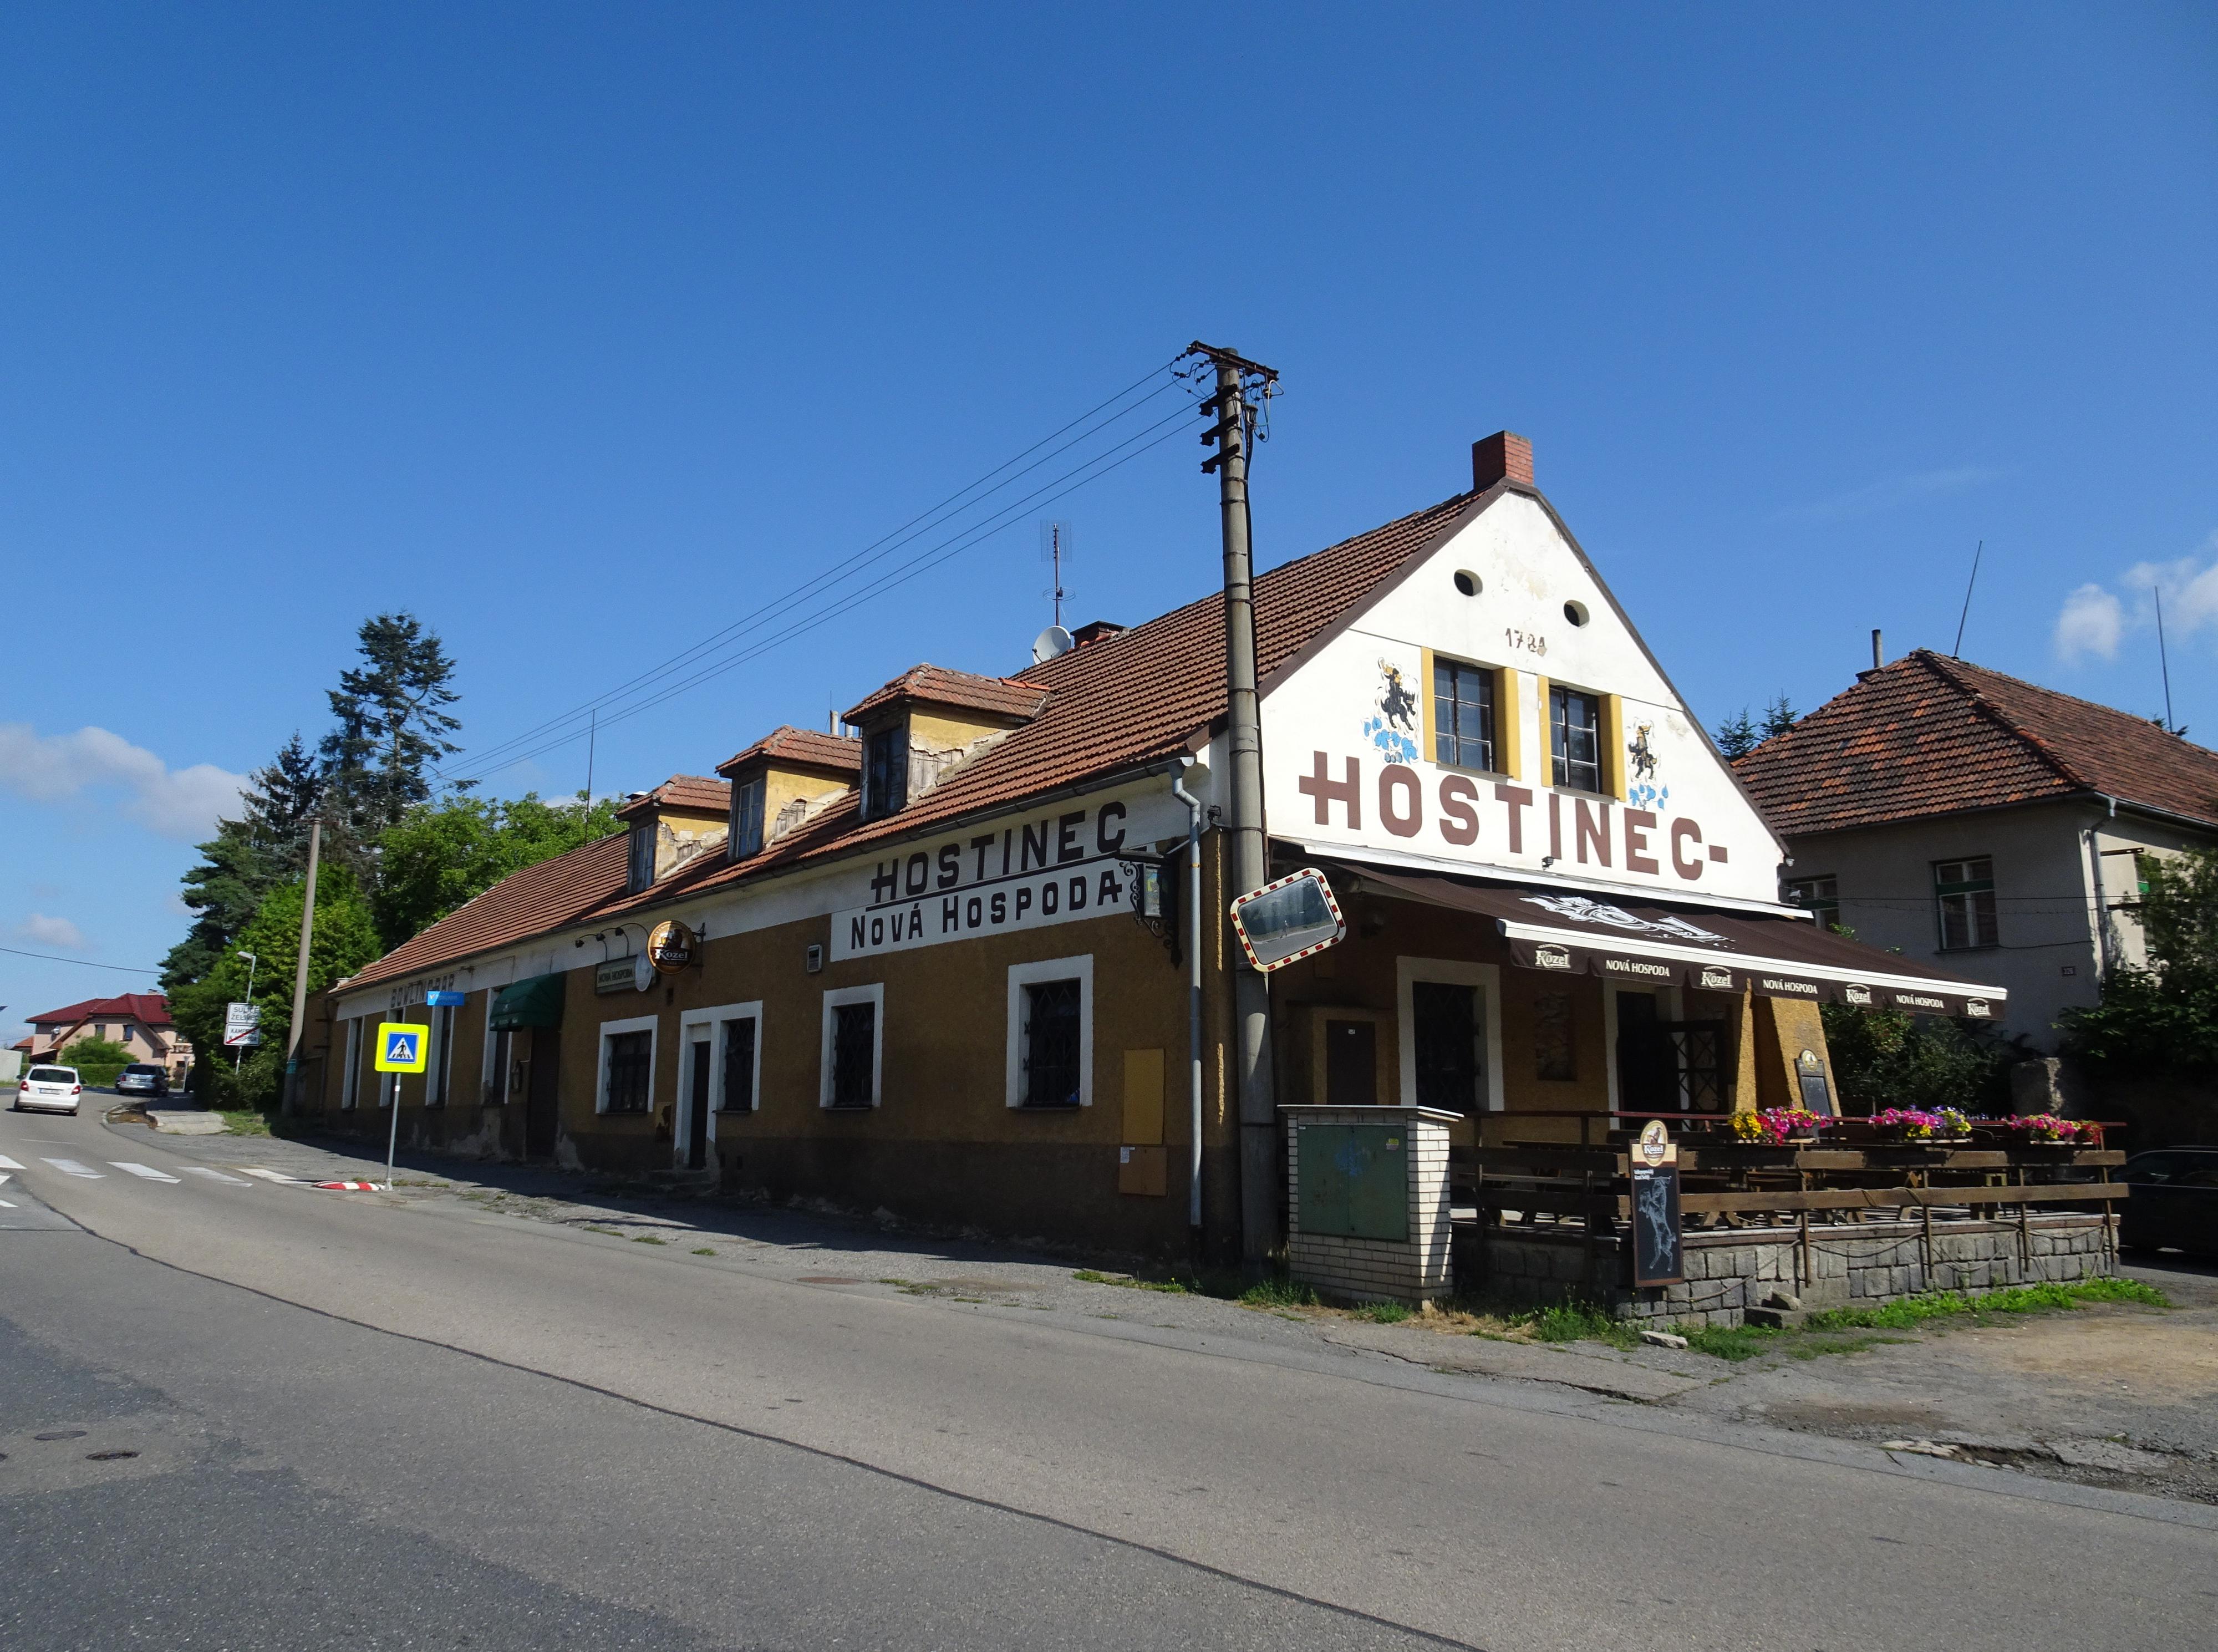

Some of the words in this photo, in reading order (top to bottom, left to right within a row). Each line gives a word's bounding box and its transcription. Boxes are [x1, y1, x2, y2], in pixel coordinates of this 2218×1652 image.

[871, 801, 1127, 903] HOSTINEC
[851, 903, 924, 949] NOVÁ
[943, 870, 1123, 933] HOSPODA
[654, 949, 688, 960] Kozel
[1535, 950, 1571, 969] Kozel
[1606, 959, 1630, 972] NOVÁ
[1631, 963, 1670, 977] HOSPODA
[1701, 972, 1733, 988] Kozel
[1763, 978, 1784, 990] NOVÁ
[1784, 982, 1818, 994] HOSPODA
[1845, 989, 1872, 1004] Kozel
[1896, 994, 1915, 1005] NOVÁ
[1915, 997, 1944, 1008] HOSPODA
[1967, 1003, 1992, 1017] Kozel
[1644, 1145, 1664, 1155] Kozel
